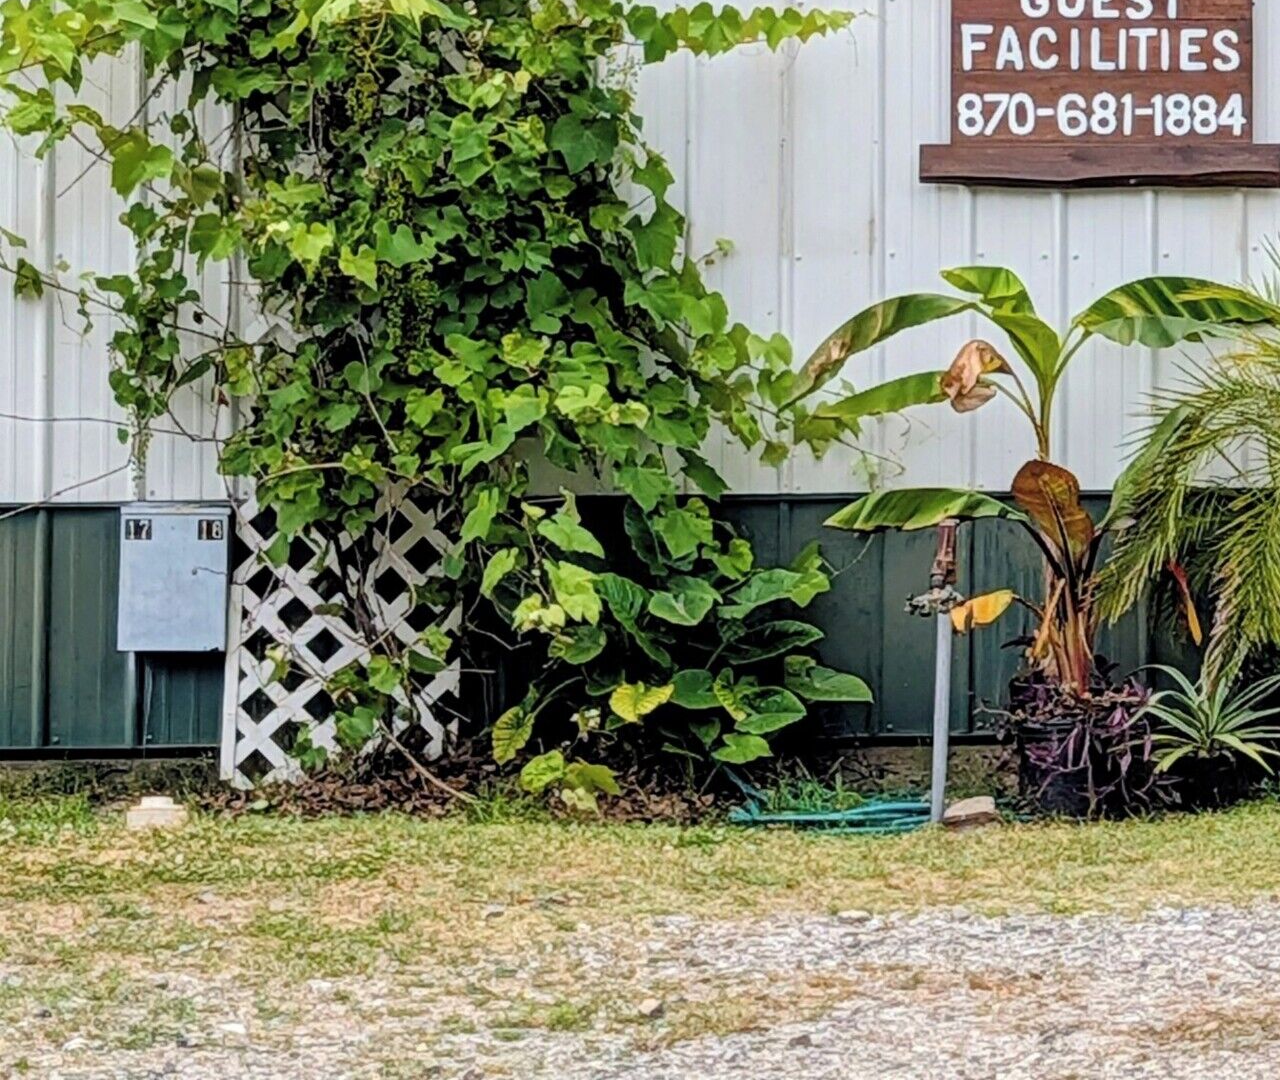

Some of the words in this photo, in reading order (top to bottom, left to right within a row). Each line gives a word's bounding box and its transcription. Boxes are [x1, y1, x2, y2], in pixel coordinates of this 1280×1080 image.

[960, 23, 1240, 72] FACILITIES
[957, 91, 1247, 137] 870-681-1884
[127, 520, 151, 540] 17
[201, 520, 223, 539] 18
